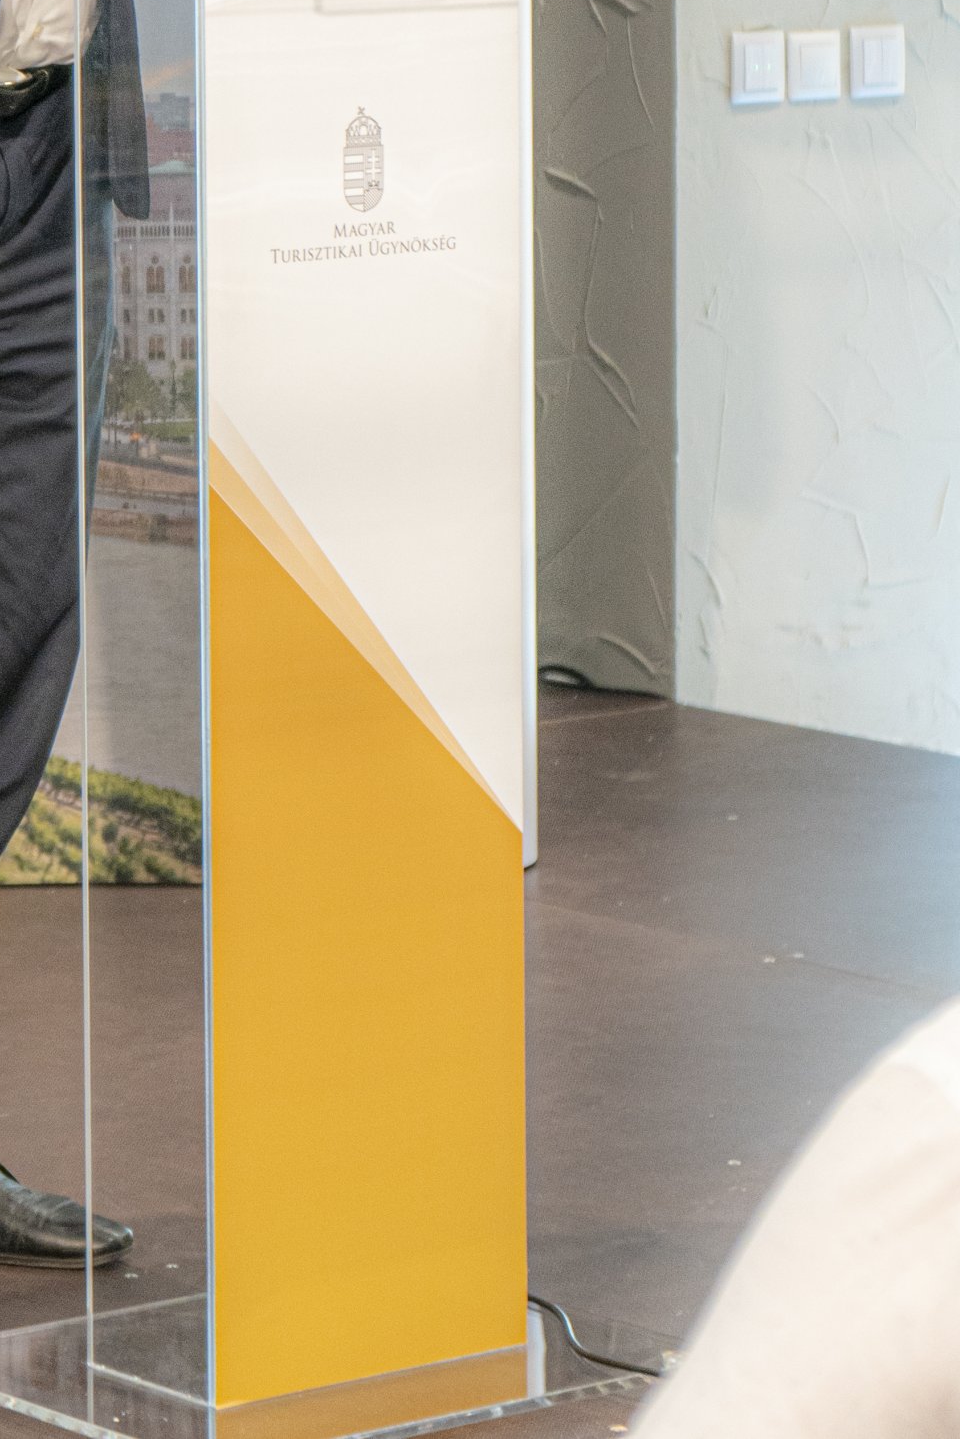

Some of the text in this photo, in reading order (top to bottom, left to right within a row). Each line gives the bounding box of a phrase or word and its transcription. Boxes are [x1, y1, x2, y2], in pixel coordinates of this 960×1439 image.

[334, 221, 396, 238] MAGYAR
[271, 234, 457, 264] TURISZTIKAI ÜGYNÖKSÉG
